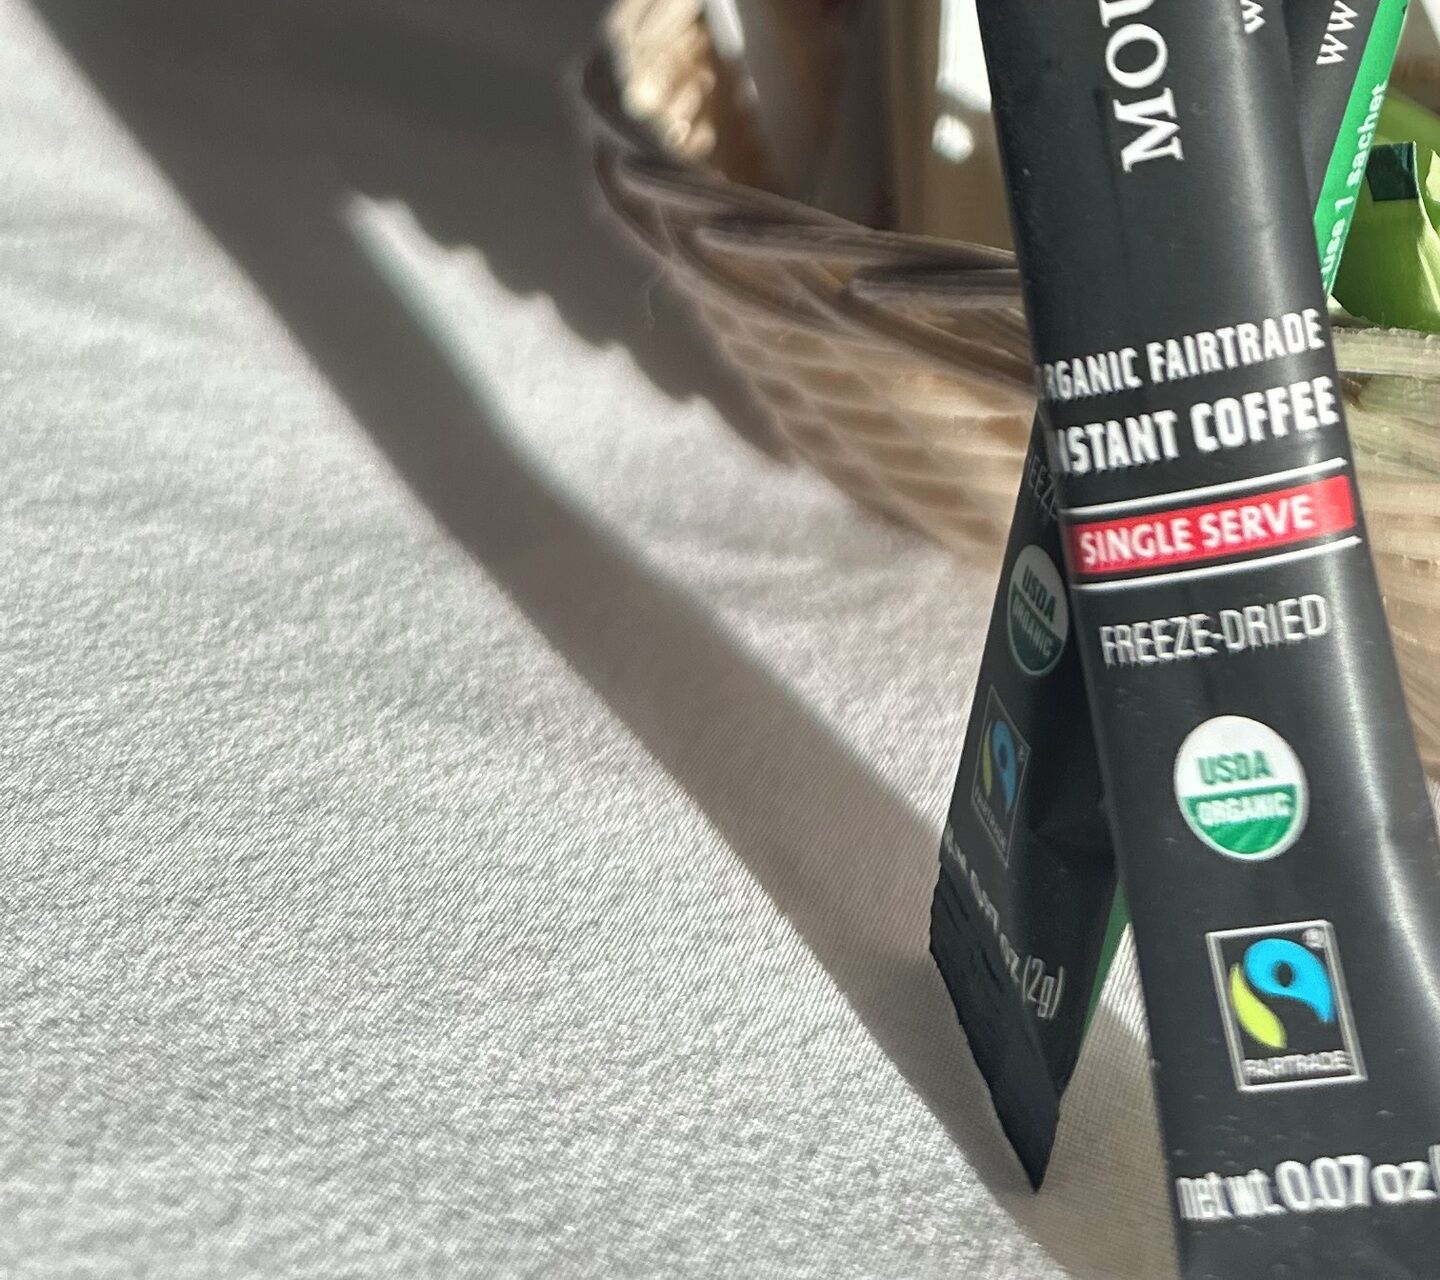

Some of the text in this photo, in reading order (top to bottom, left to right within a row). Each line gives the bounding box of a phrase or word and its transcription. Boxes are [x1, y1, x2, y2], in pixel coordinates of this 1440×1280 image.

[1346, 78, 1389, 188] sachet
[1038, 307, 1326, 403] RGANIC FAIRTRADE
[1189, 375, 1340, 454] COFFEE
[1079, 493, 1318, 567] SINGLE SERVE
[1021, 564, 1057, 623] USDA
[1099, 592, 1330, 669] FREEZE-DRIED
[1196, 749, 1275, 787] USDA
[1194, 790, 1293, 827] ORGANIC
[1242, 1047, 1354, 1082] FAIRTRADE
[1175, 1171, 1233, 1221] net
[1275, 1153, 1373, 1212] 0.07
[1371, 1160, 1437, 1205] oz
